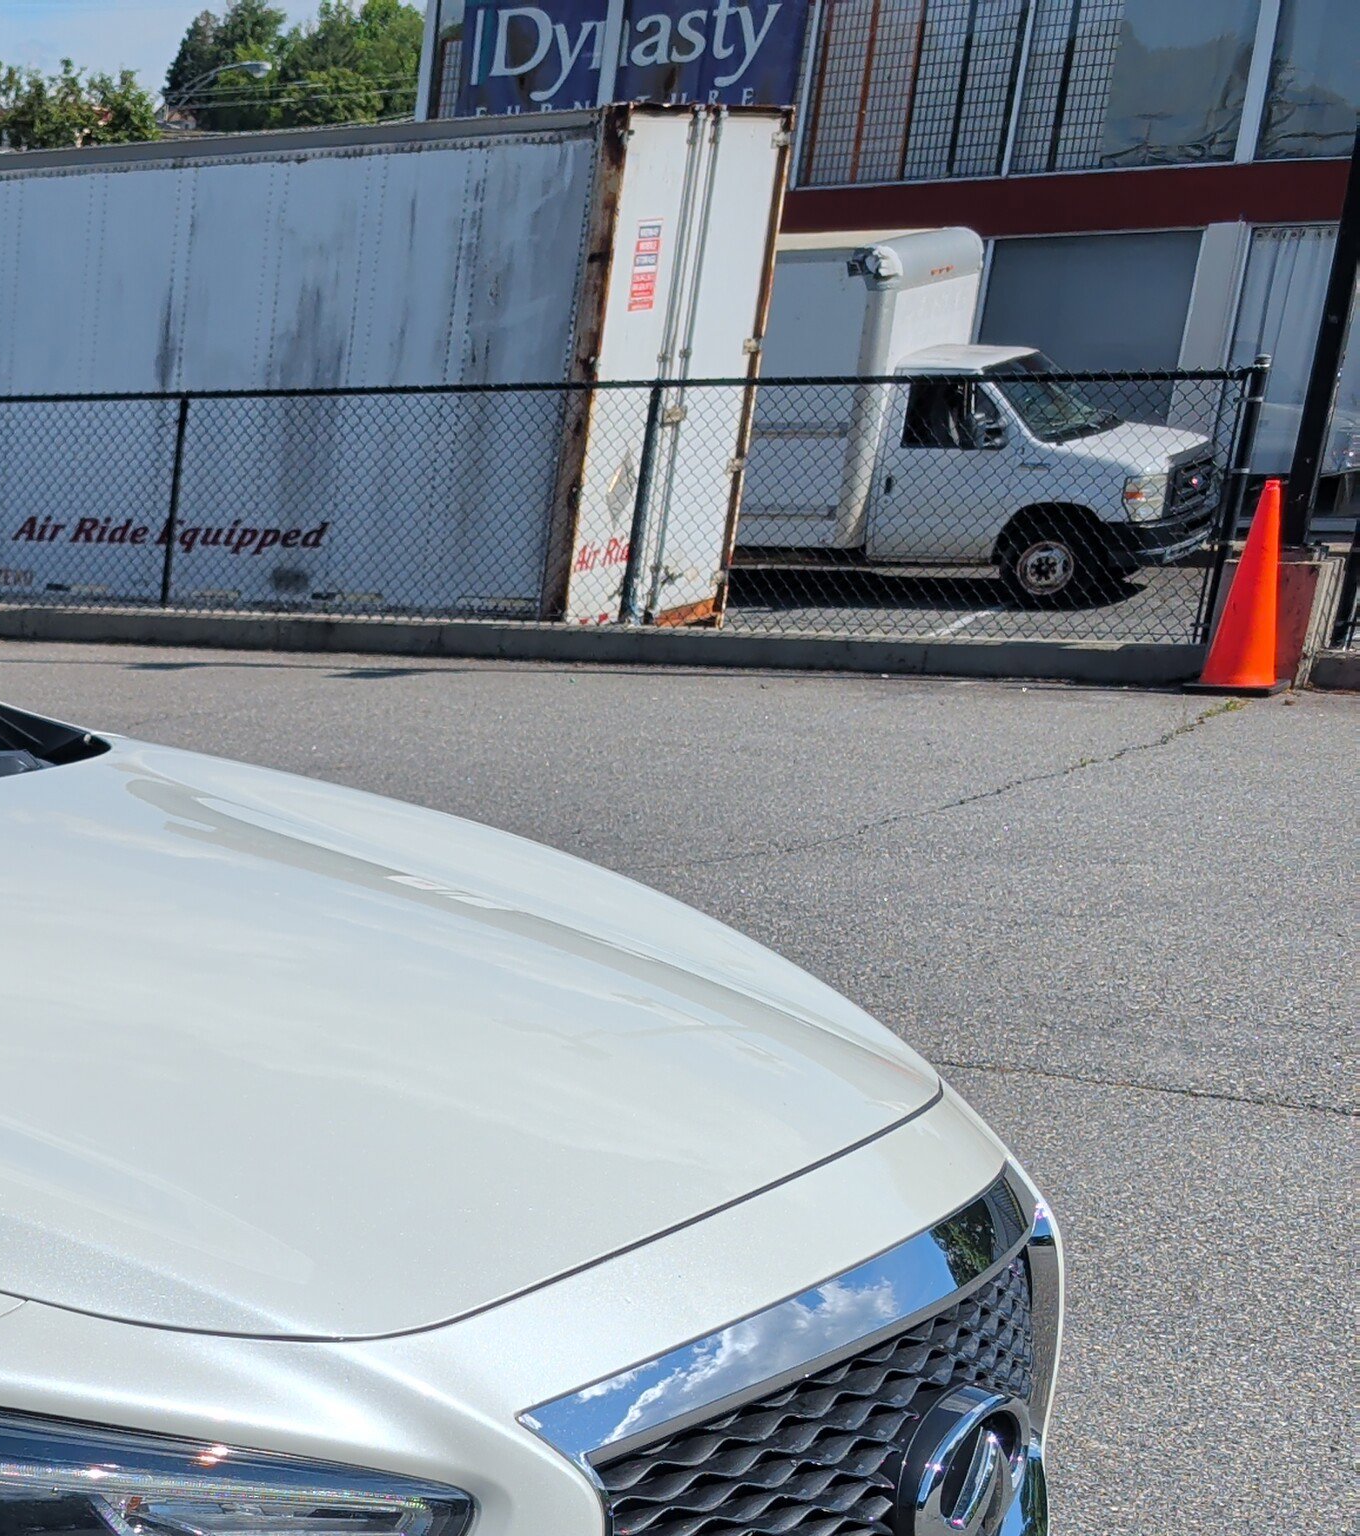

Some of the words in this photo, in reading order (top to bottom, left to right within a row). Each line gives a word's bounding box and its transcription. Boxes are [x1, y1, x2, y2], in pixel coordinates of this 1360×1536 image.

[12, 515, 66, 542] Air
[69, 517, 149, 544] Ride
[573, 541, 600, 572] Air
